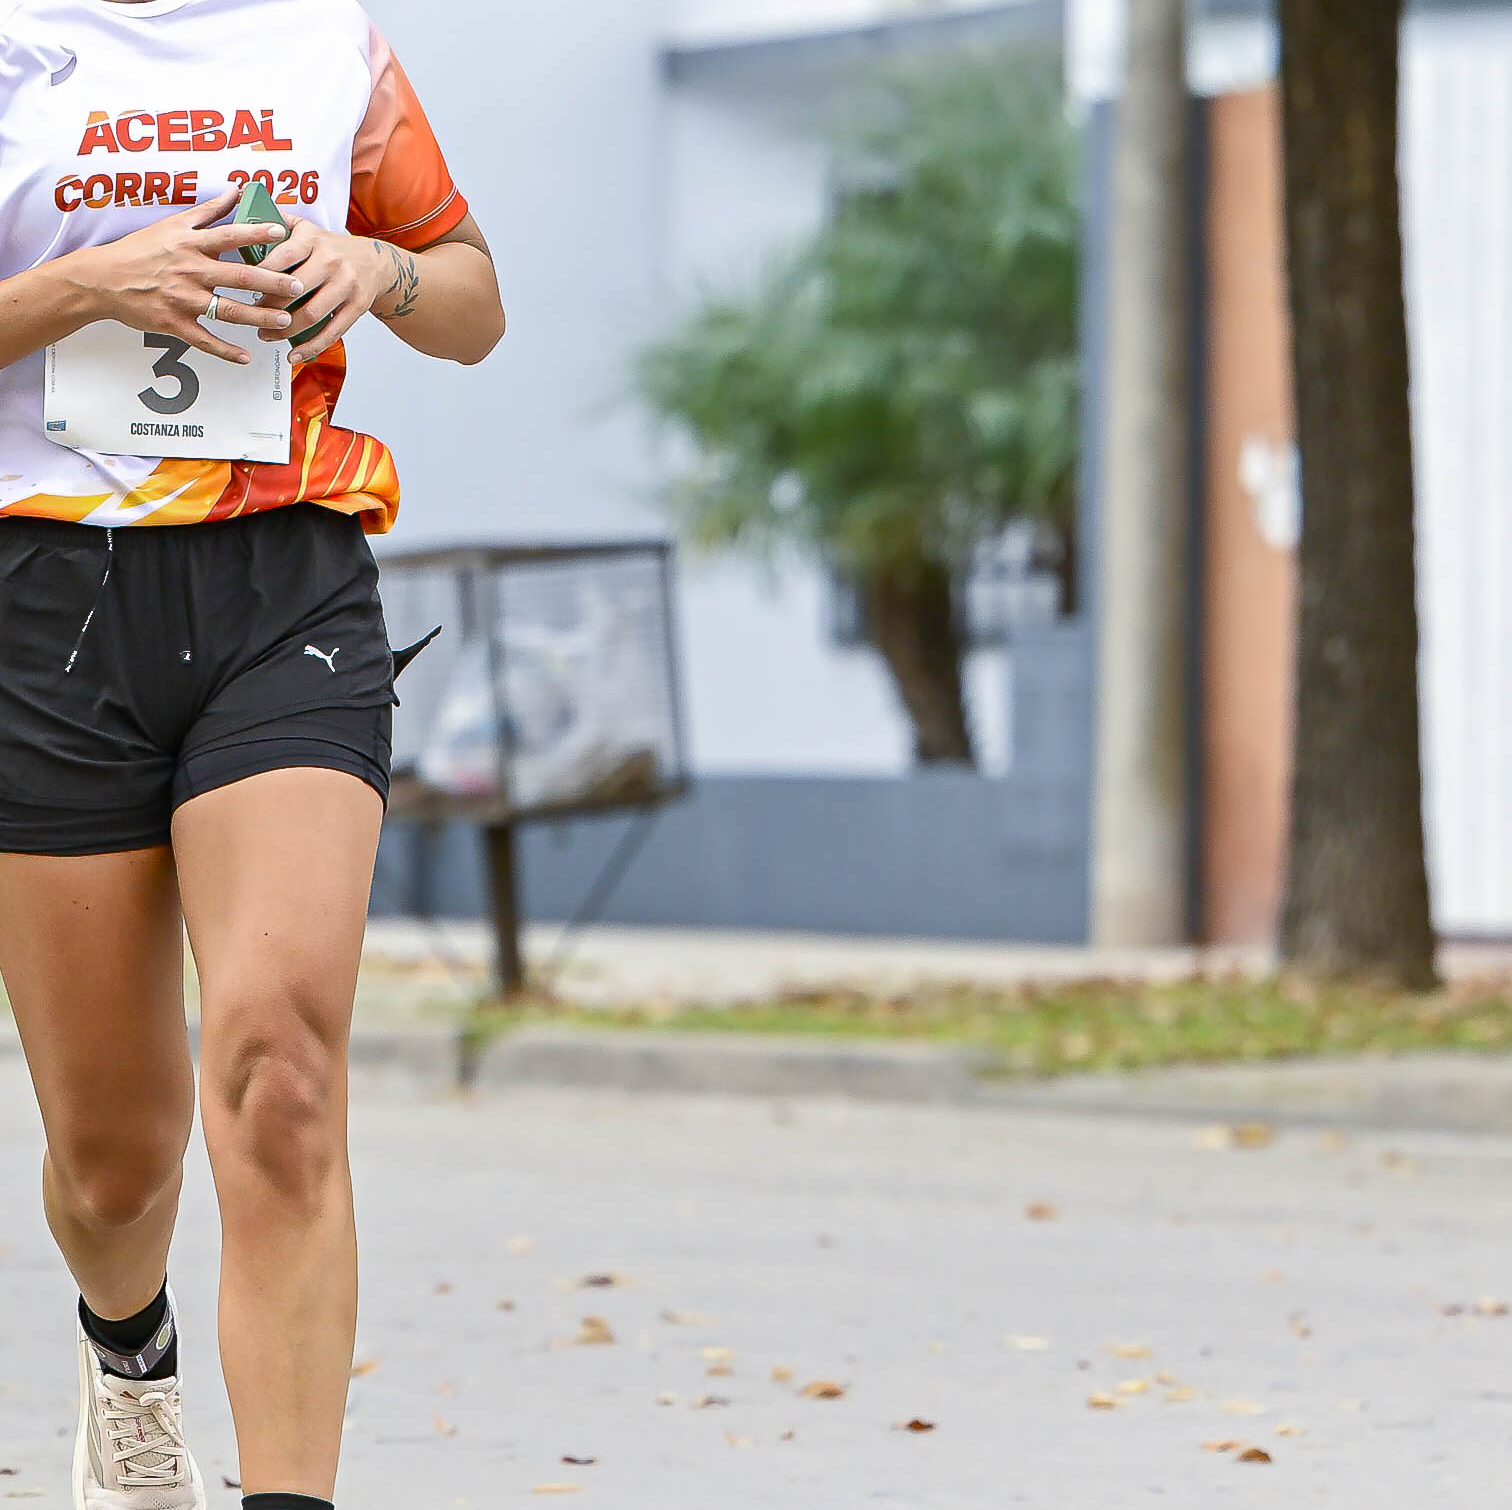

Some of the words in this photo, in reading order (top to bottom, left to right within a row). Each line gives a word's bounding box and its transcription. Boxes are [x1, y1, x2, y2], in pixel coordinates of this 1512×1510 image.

[77, 109, 292, 155] ACEBAL
[54, 171, 198, 212] CORRE
[137, 331, 200, 415] 3
[130, 422, 180, 437] COSTANZA
[182, 425, 204, 438] RIOS
